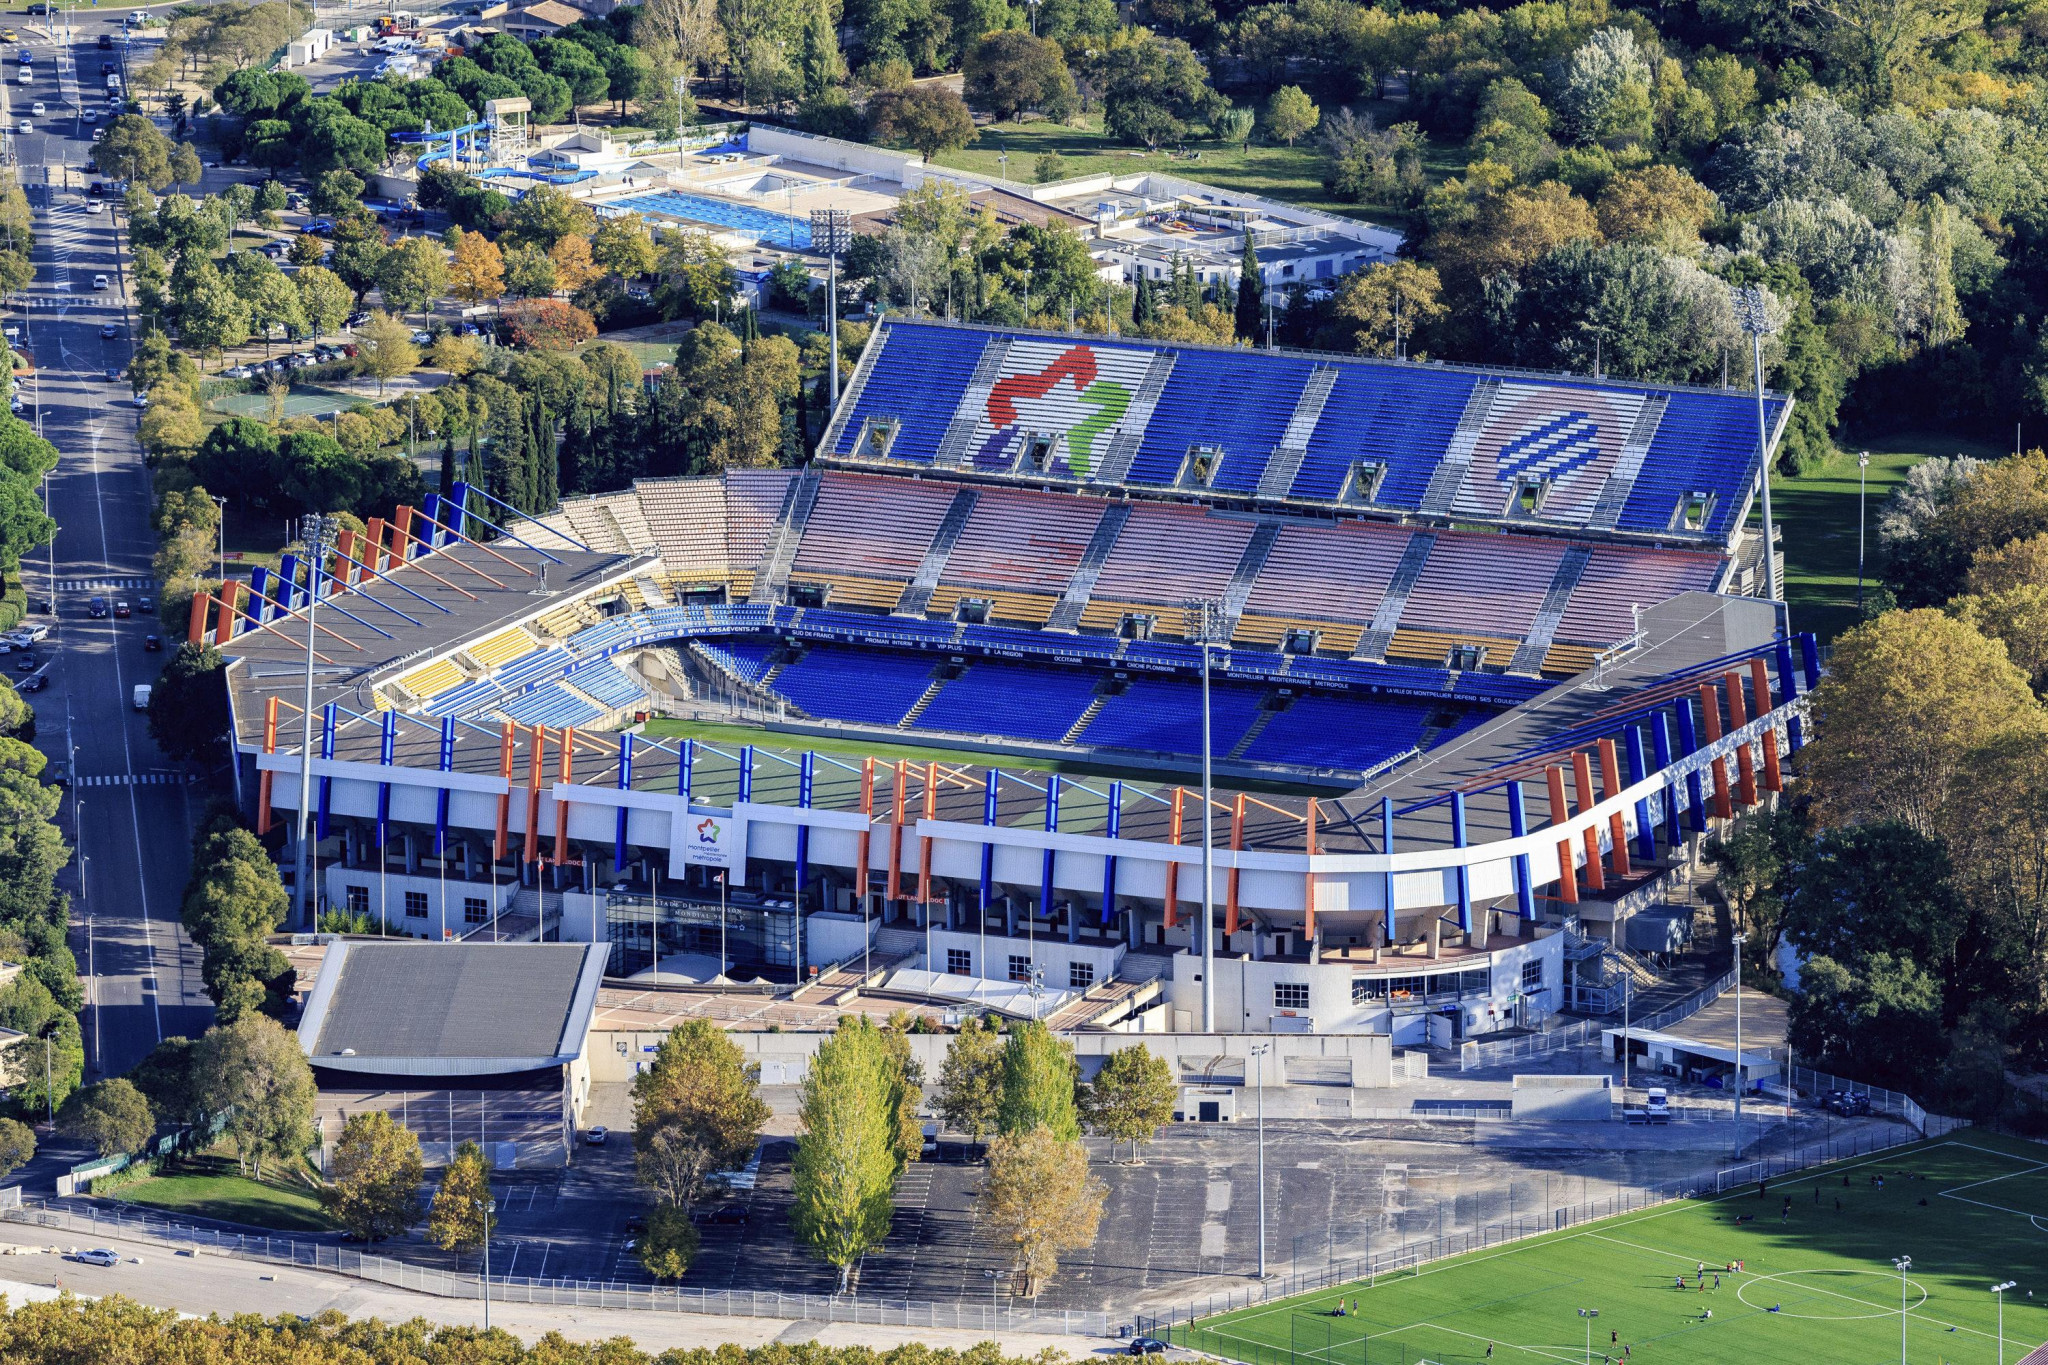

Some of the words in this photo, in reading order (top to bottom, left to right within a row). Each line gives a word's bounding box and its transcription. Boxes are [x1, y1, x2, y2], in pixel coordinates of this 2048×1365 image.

[656, 630, 675, 638] STORE
[813, 631, 835, 639] FRANCE
[865, 637, 890, 645] PROMAN
[1054, 655, 1083, 664] OCCITANIE
[1146, 663, 1176, 672] PLOMBERIE
[1226, 672, 1265, 681] MONTPELLIER
[1314, 680, 1349, 689] METROPOLE
[1413, 689, 1452, 699] MONTPELLIER
[1454, 693, 1477, 701] DEFEND
[655, 900, 679, 908] STADE
[710, 905, 742, 915] MOSON
[674, 910, 710, 919] MONDIAL
